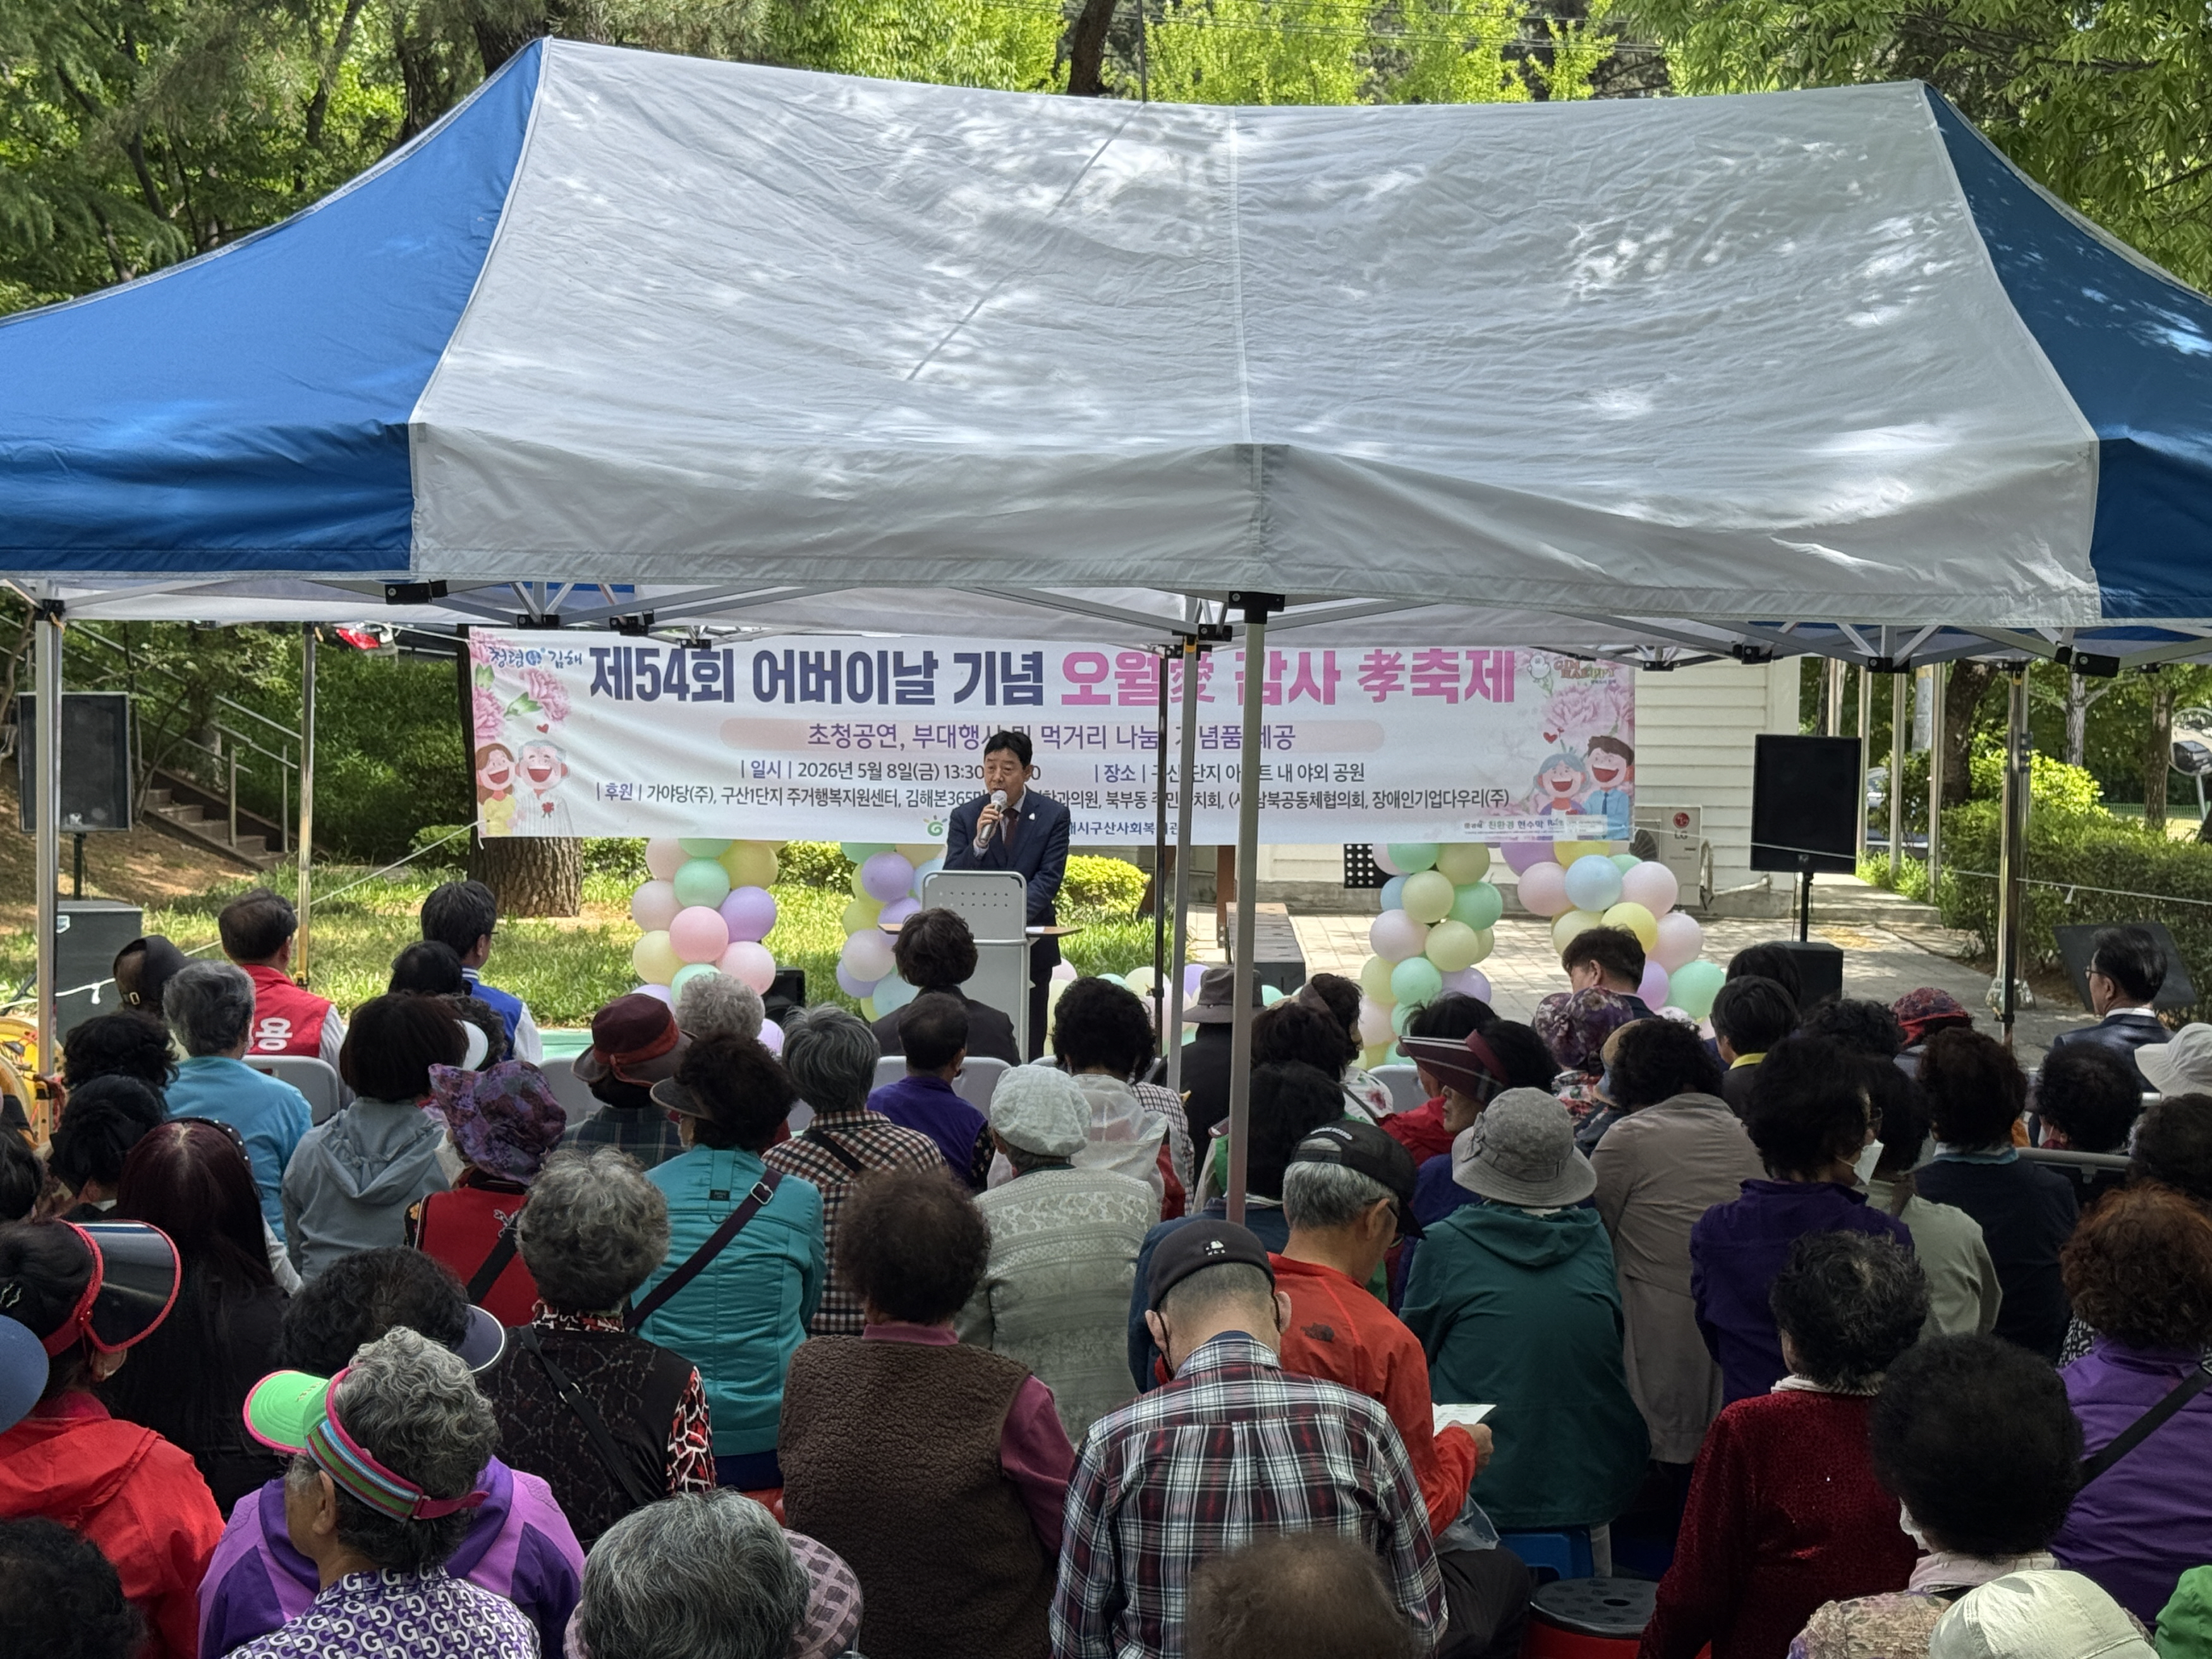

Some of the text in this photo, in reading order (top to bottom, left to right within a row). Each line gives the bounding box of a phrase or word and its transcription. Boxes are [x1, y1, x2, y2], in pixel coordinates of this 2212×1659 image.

[488, 647, 583, 669] 청렴 김해
[588, 646, 735, 703] 제54회
[752, 649, 939, 706] 어버이날
[953, 651, 1044, 707] 기념
[1358, 648, 1515, 704] 孝축제
[808, 723, 905, 751] 초청공연,
[1041, 725, 1107, 750] 먹거리
[1117, 726, 1158, 750] 나눔
[751, 761, 782, 779] 일시
[798, 762, 854, 781] 2026년
[858, 762, 882, 781] 5월
[887, 763, 939, 782] 8일(금)
[1104, 764, 1136, 784] 장소
[1152, 763, 1220, 784] 산단지
[1226, 763, 1273, 784] 아트
[1278, 763, 1292, 783] 내
[1297, 763, 1328, 783] 야외
[1333, 763, 1365, 783] 공원
[605, 782, 633, 801] 후원
[647, 784, 717, 806] 가야당(주),
[720, 786, 782, 807] 구산1단지
[787, 787, 901, 809] 주거행복지원센터,
[1105, 791, 1148, 810] 북부동
[1152, 791, 1224, 810] 민치회,
[1229, 790, 1368, 811] (남북공동체협의회,
[1371, 789, 1509, 810] 장애인기업다우리(주)
